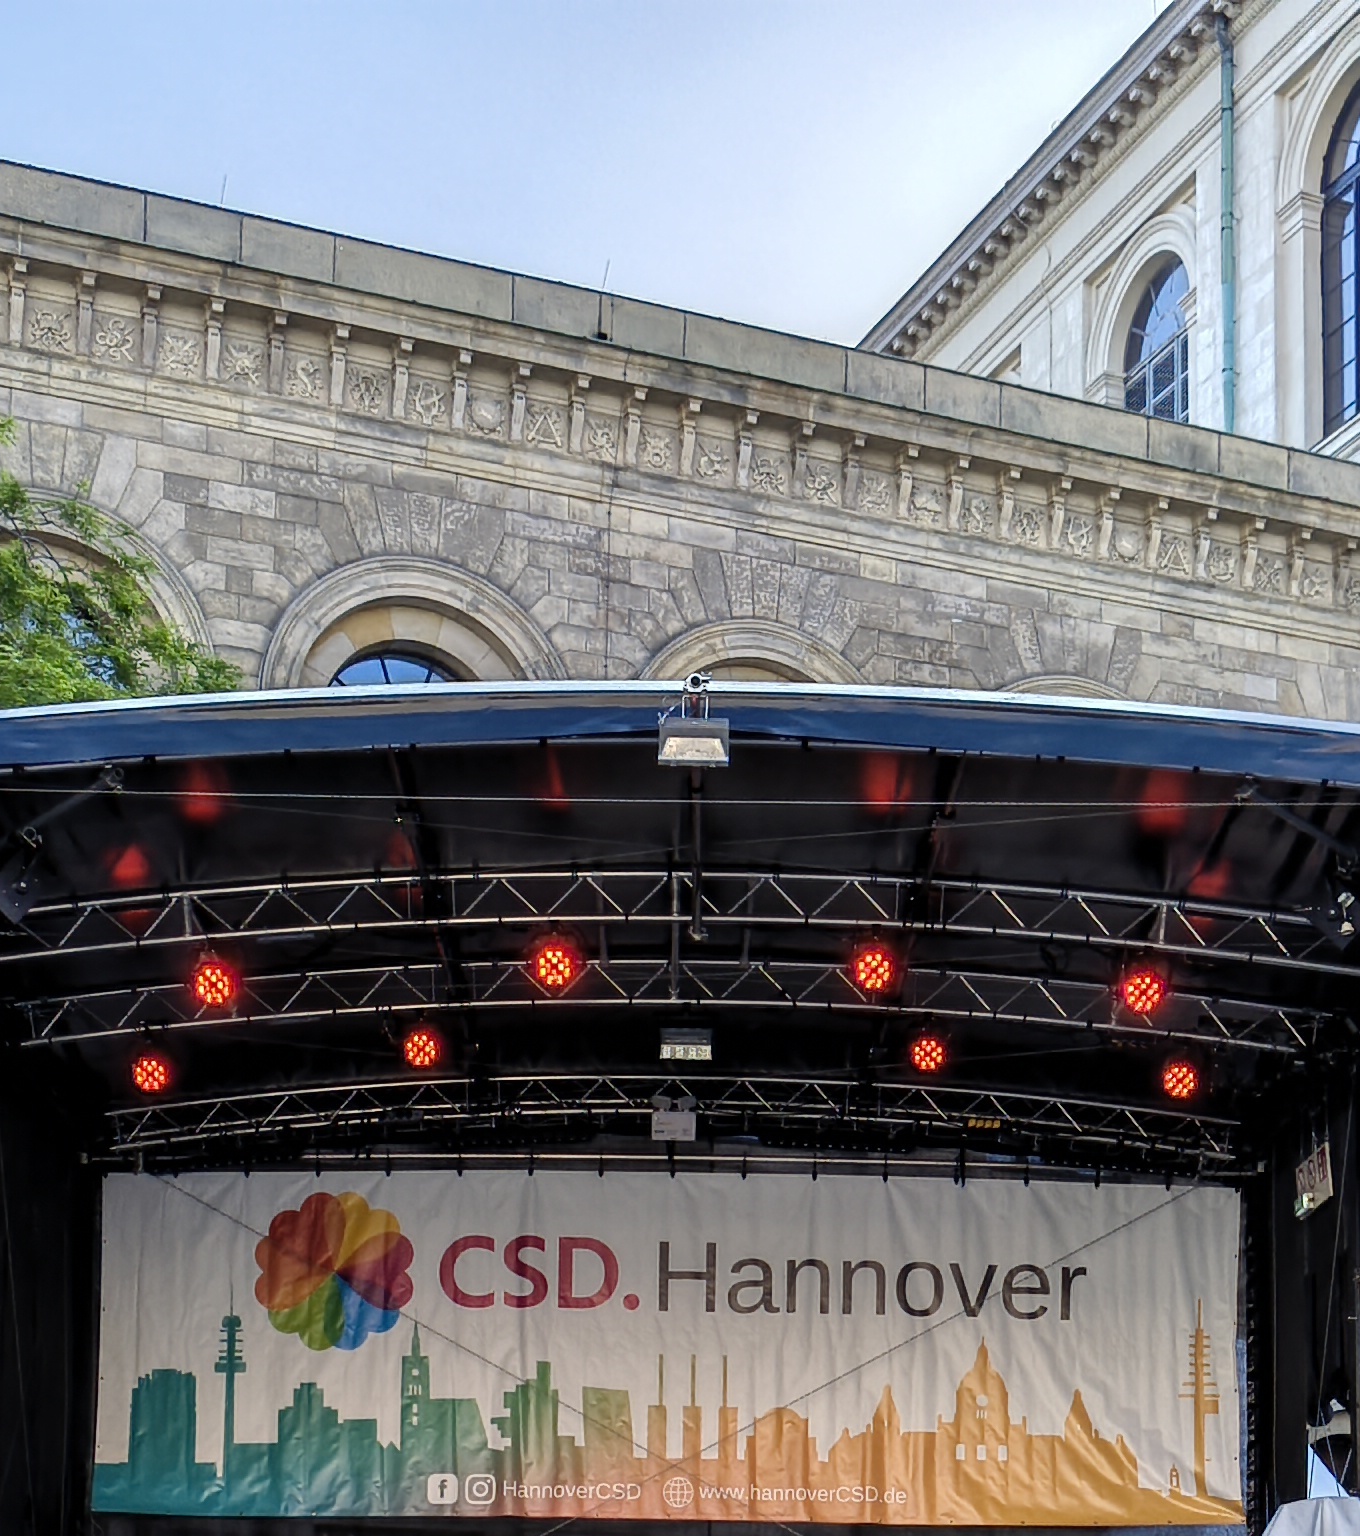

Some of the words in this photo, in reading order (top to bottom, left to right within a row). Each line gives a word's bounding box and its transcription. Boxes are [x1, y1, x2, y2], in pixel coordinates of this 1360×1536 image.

[438, 1234, 641, 1313] CSD.
[657, 1240, 1089, 1322] Hannover
[502, 1479, 641, 1500] HannoverCSD
[698, 1483, 908, 1504] www.hannoverCSD.de
